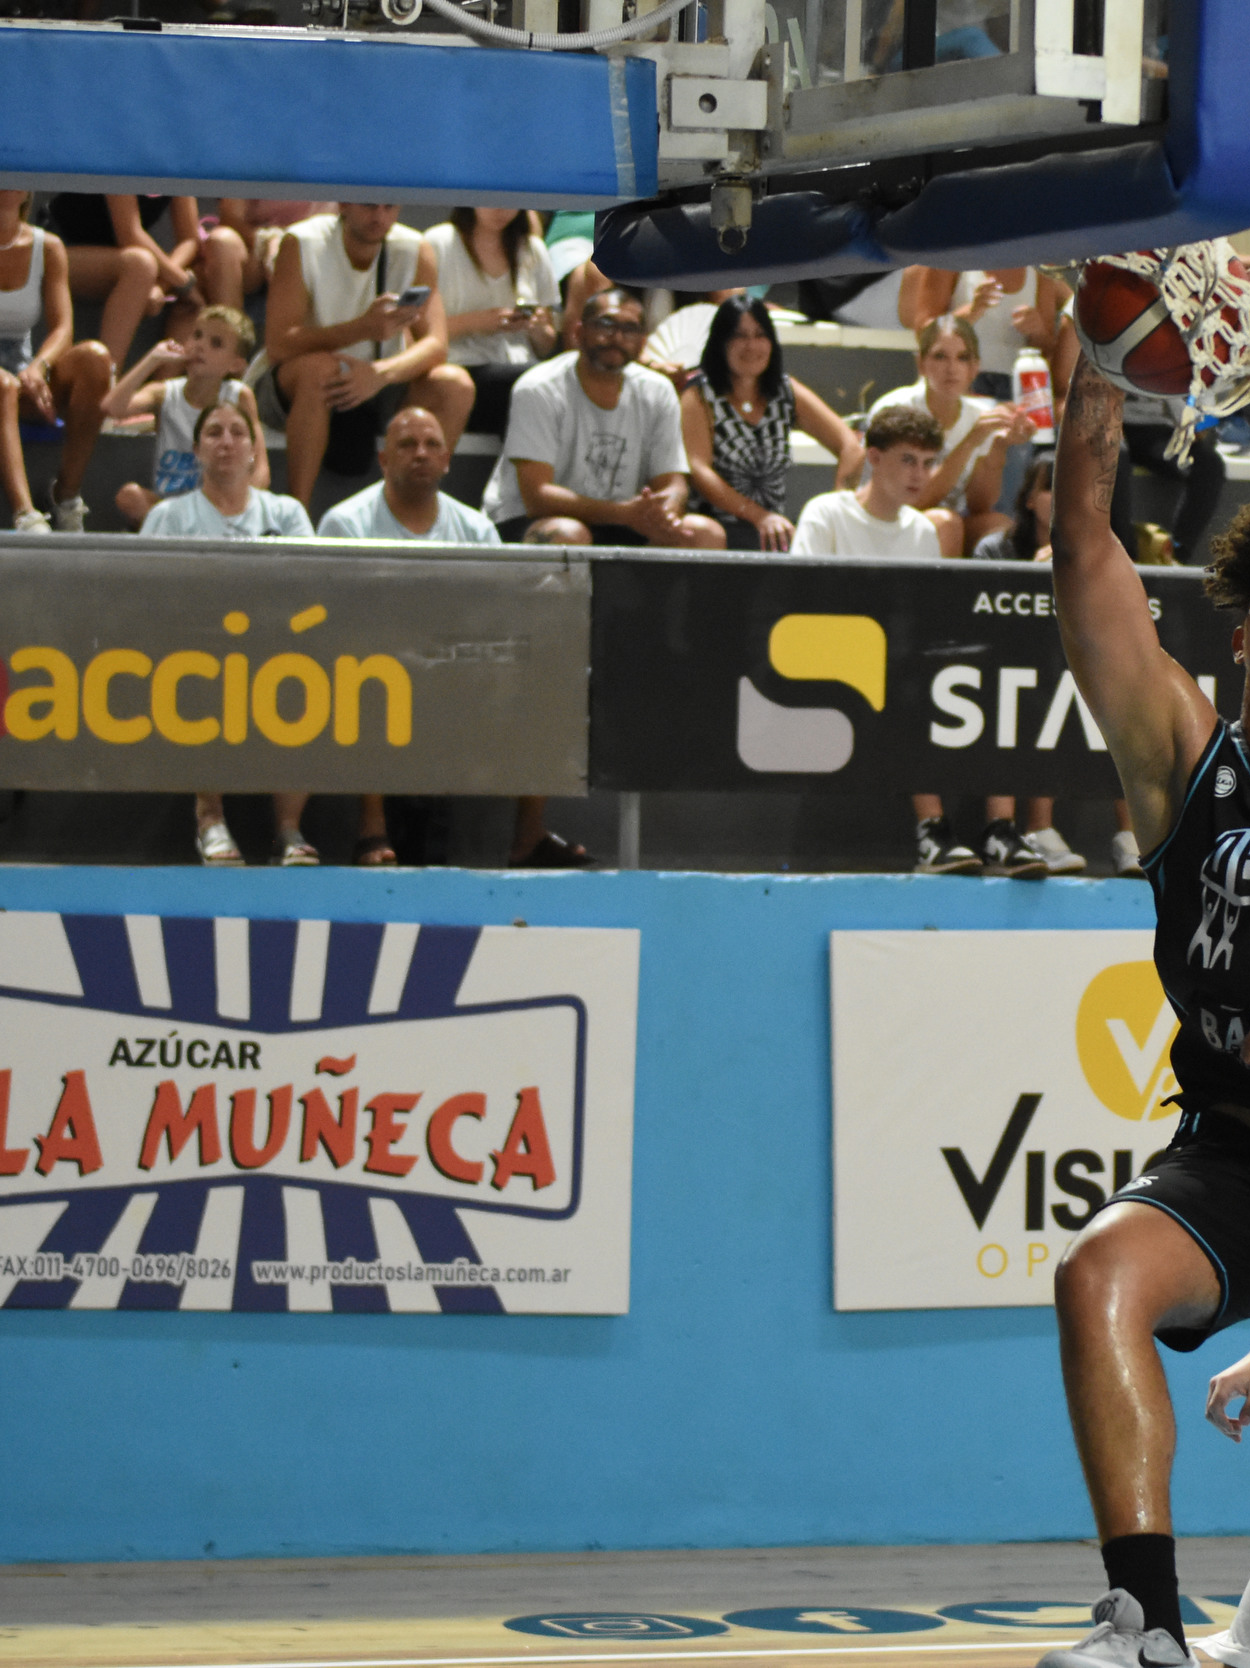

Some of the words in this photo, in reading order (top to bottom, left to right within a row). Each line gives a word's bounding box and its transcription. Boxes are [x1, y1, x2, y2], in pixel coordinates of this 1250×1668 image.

[108, 1030, 261, 1070] AZÚCAR
[0, 1068, 104, 1177] LA
[137, 1053, 557, 1191] MUÑECA
[0, 1256, 231, 1281] AX:011-4700-0696/8026
[256, 1260, 571, 1285] www.productoslamuñeca.com.ar
